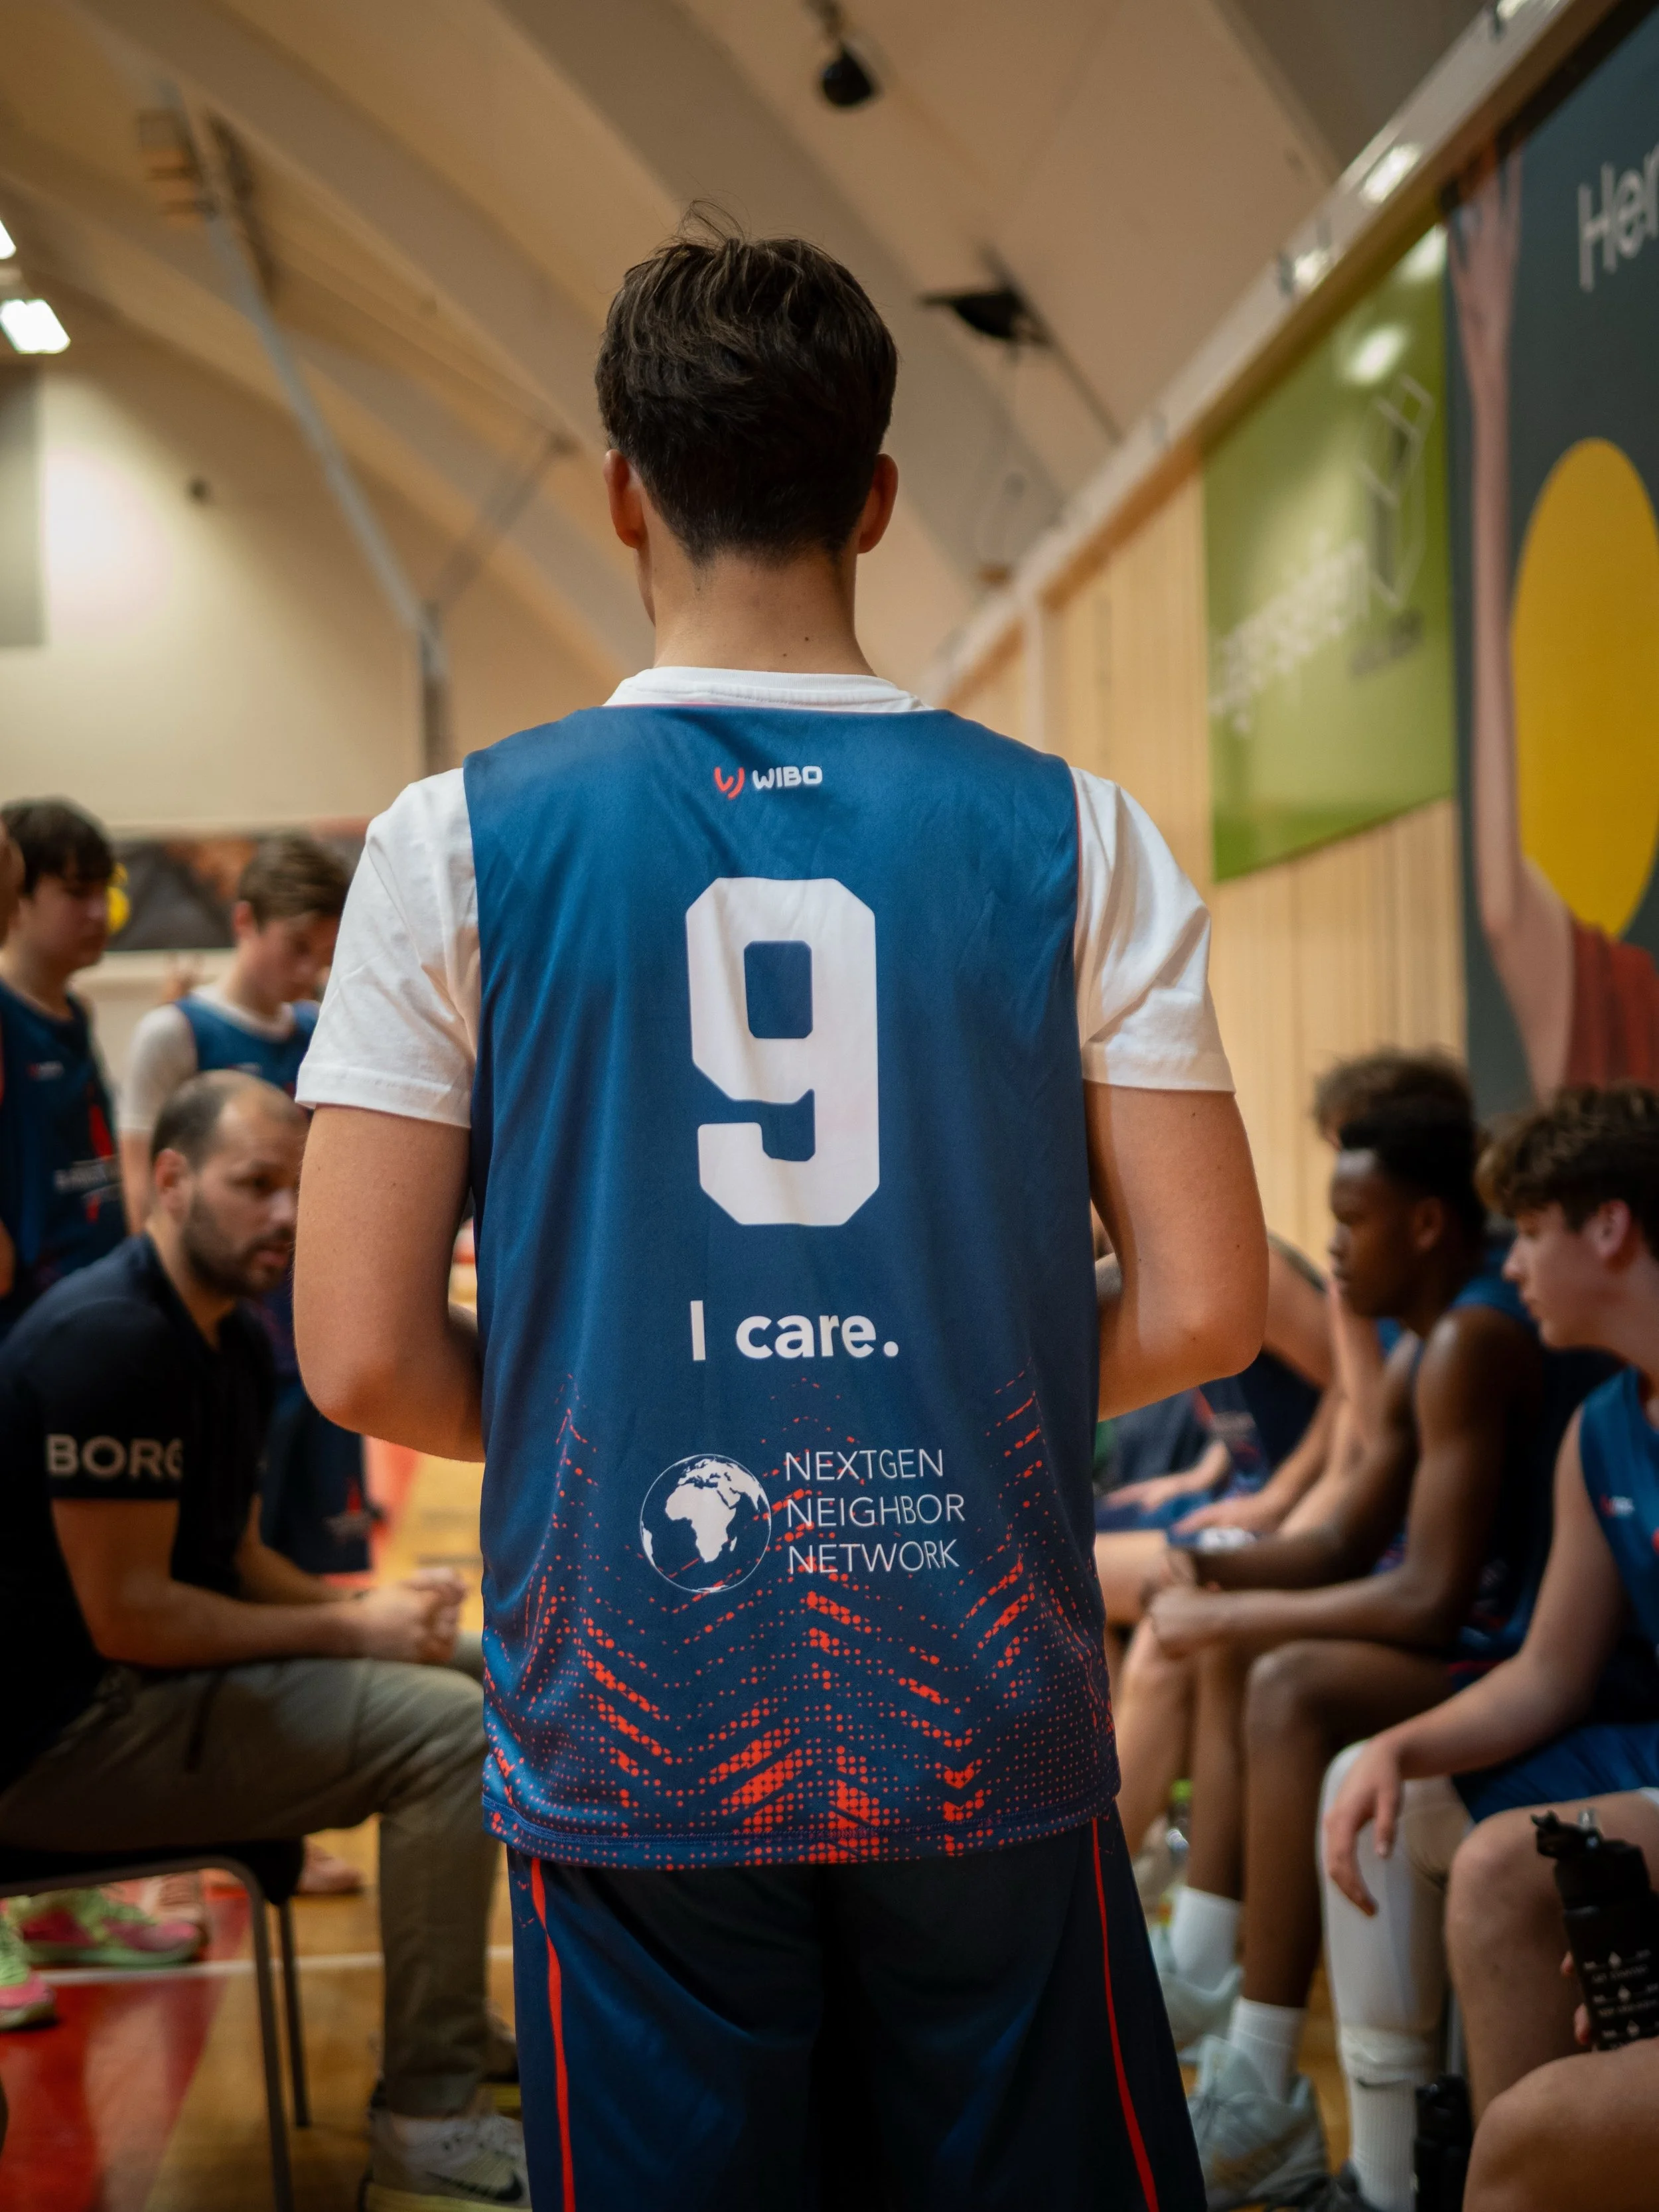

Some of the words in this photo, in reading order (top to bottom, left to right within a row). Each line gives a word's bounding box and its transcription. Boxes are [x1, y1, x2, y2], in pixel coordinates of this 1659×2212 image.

[753, 765, 823, 790] WIBO
[685, 877, 880, 1226] 9
[690, 1300, 706, 1361] I
[736, 1315, 899, 1359] care.
[785, 1448, 944, 1481] NEXTGEN
[786, 1493, 966, 1528] NEIGHBOR
[788, 1538, 960, 1575] NETWORK
